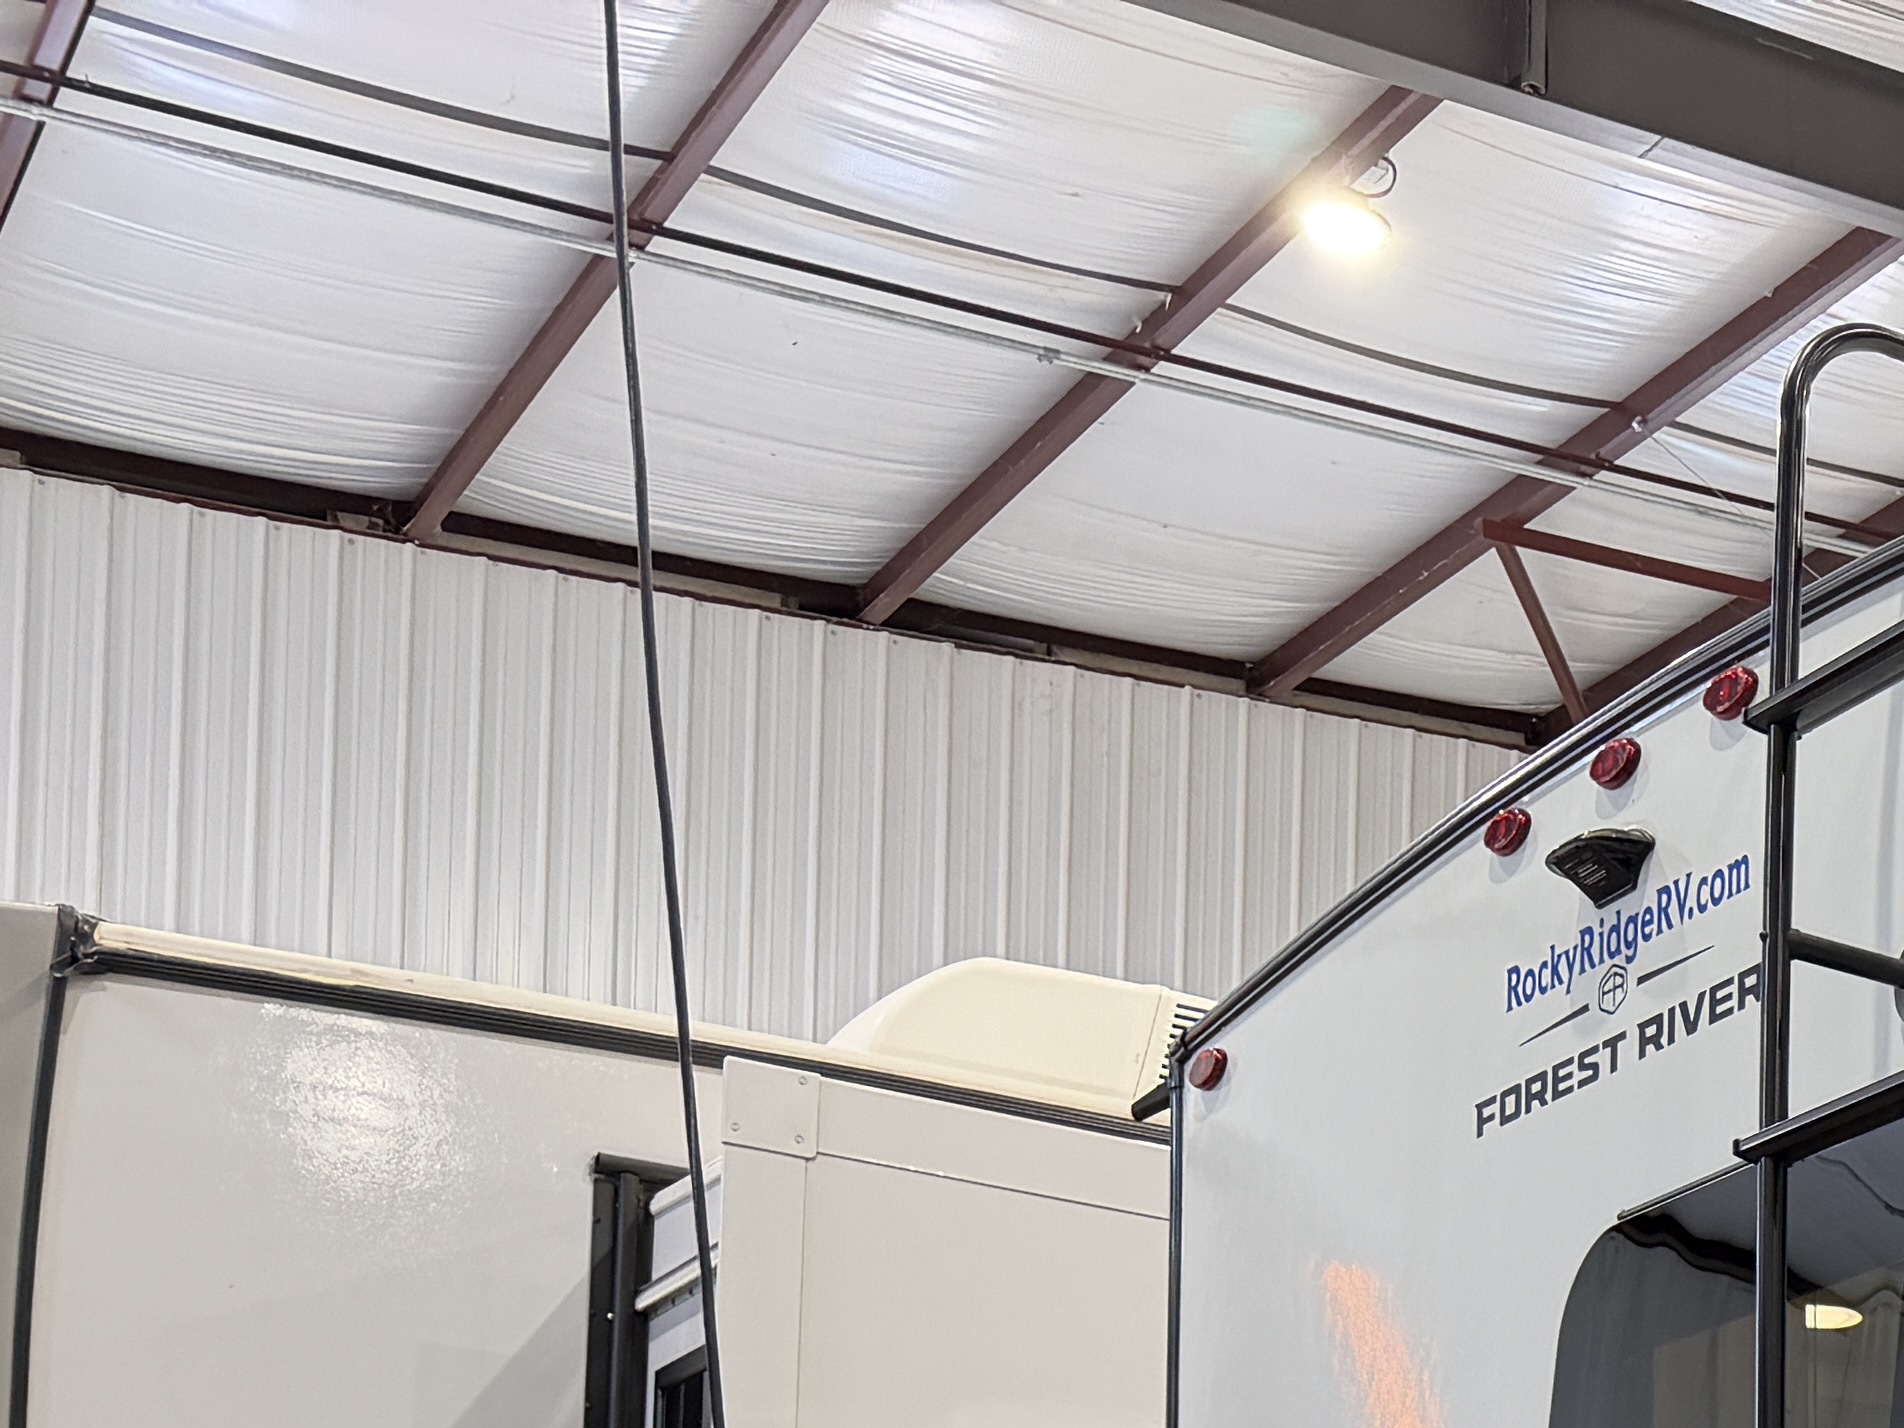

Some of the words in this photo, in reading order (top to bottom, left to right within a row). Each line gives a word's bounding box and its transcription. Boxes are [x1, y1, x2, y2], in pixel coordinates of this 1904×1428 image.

[1504, 854, 1751, 1012] RockyRidgeRV.com
[1474, 1030, 1628, 1139] FOREST
[1637, 961, 1763, 1061] RIVER
